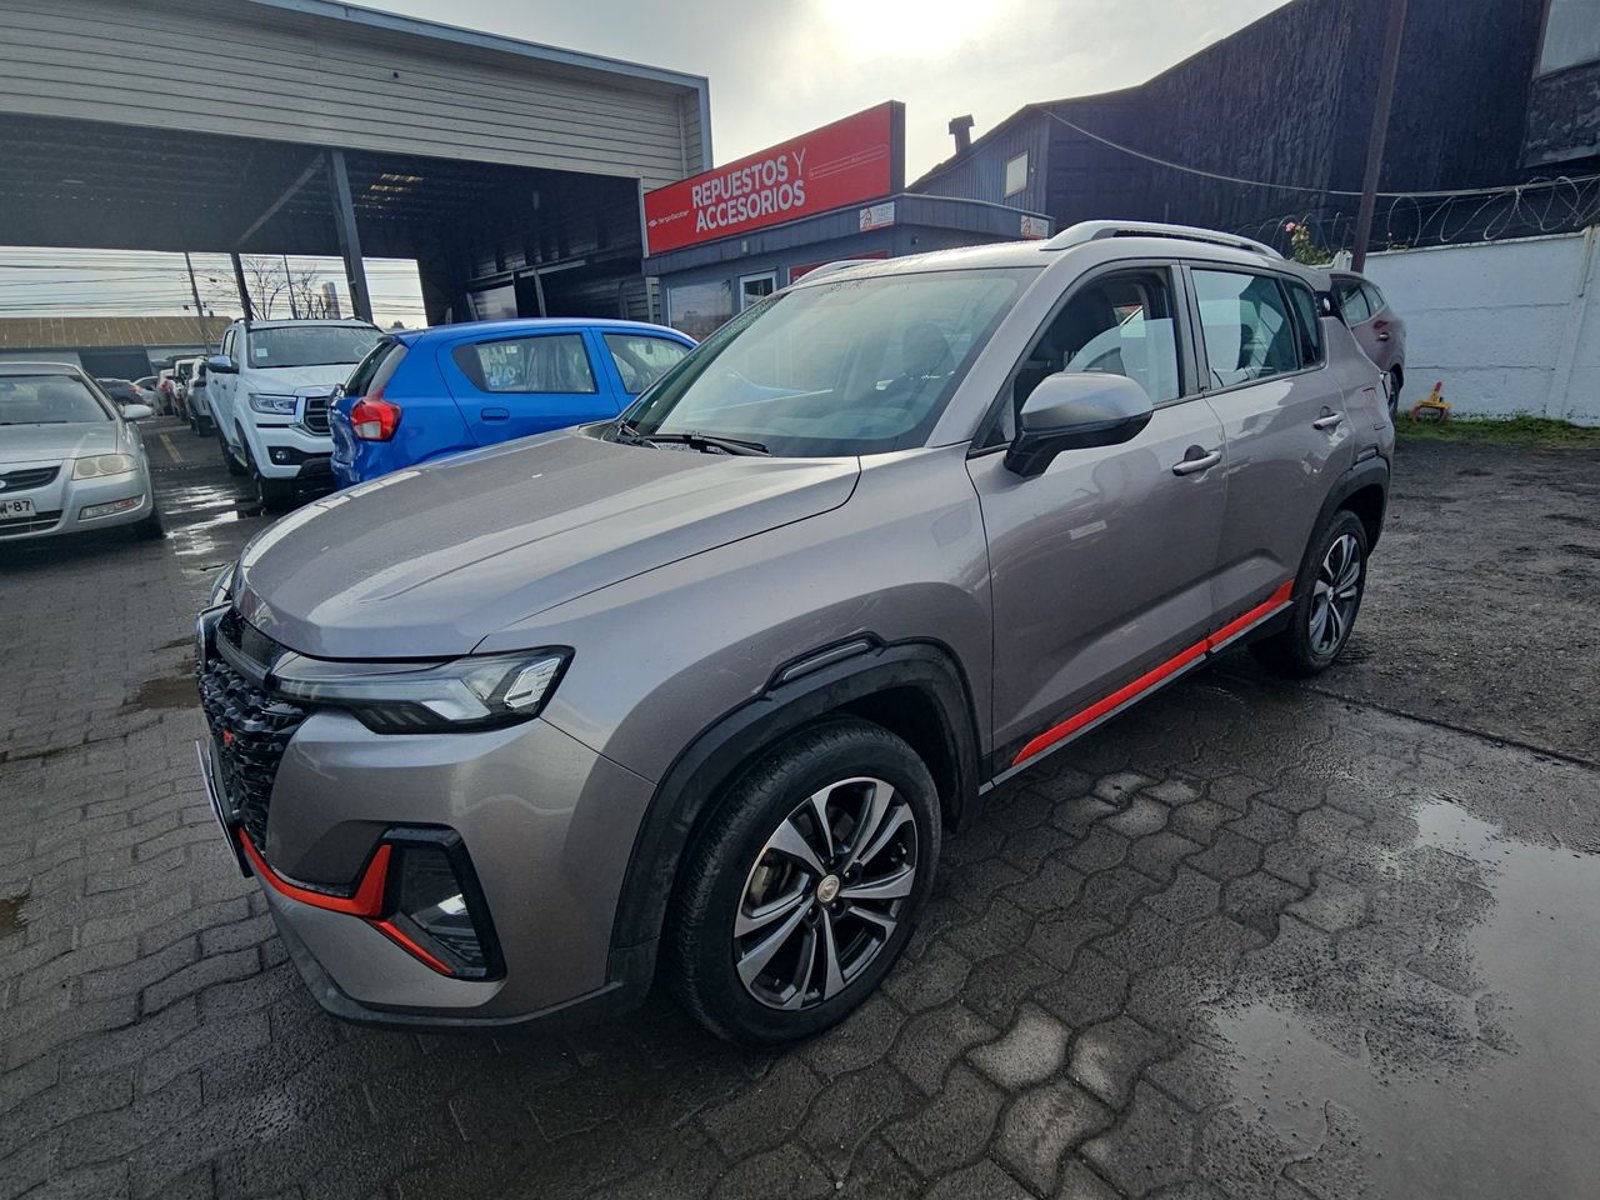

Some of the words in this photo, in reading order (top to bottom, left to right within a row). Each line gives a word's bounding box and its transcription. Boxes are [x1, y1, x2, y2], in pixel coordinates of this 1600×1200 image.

[692, 155, 787, 208] REPUESTOS
[791, 147, 806, 176] Y
[695, 180, 806, 233] ACCESORIOS
